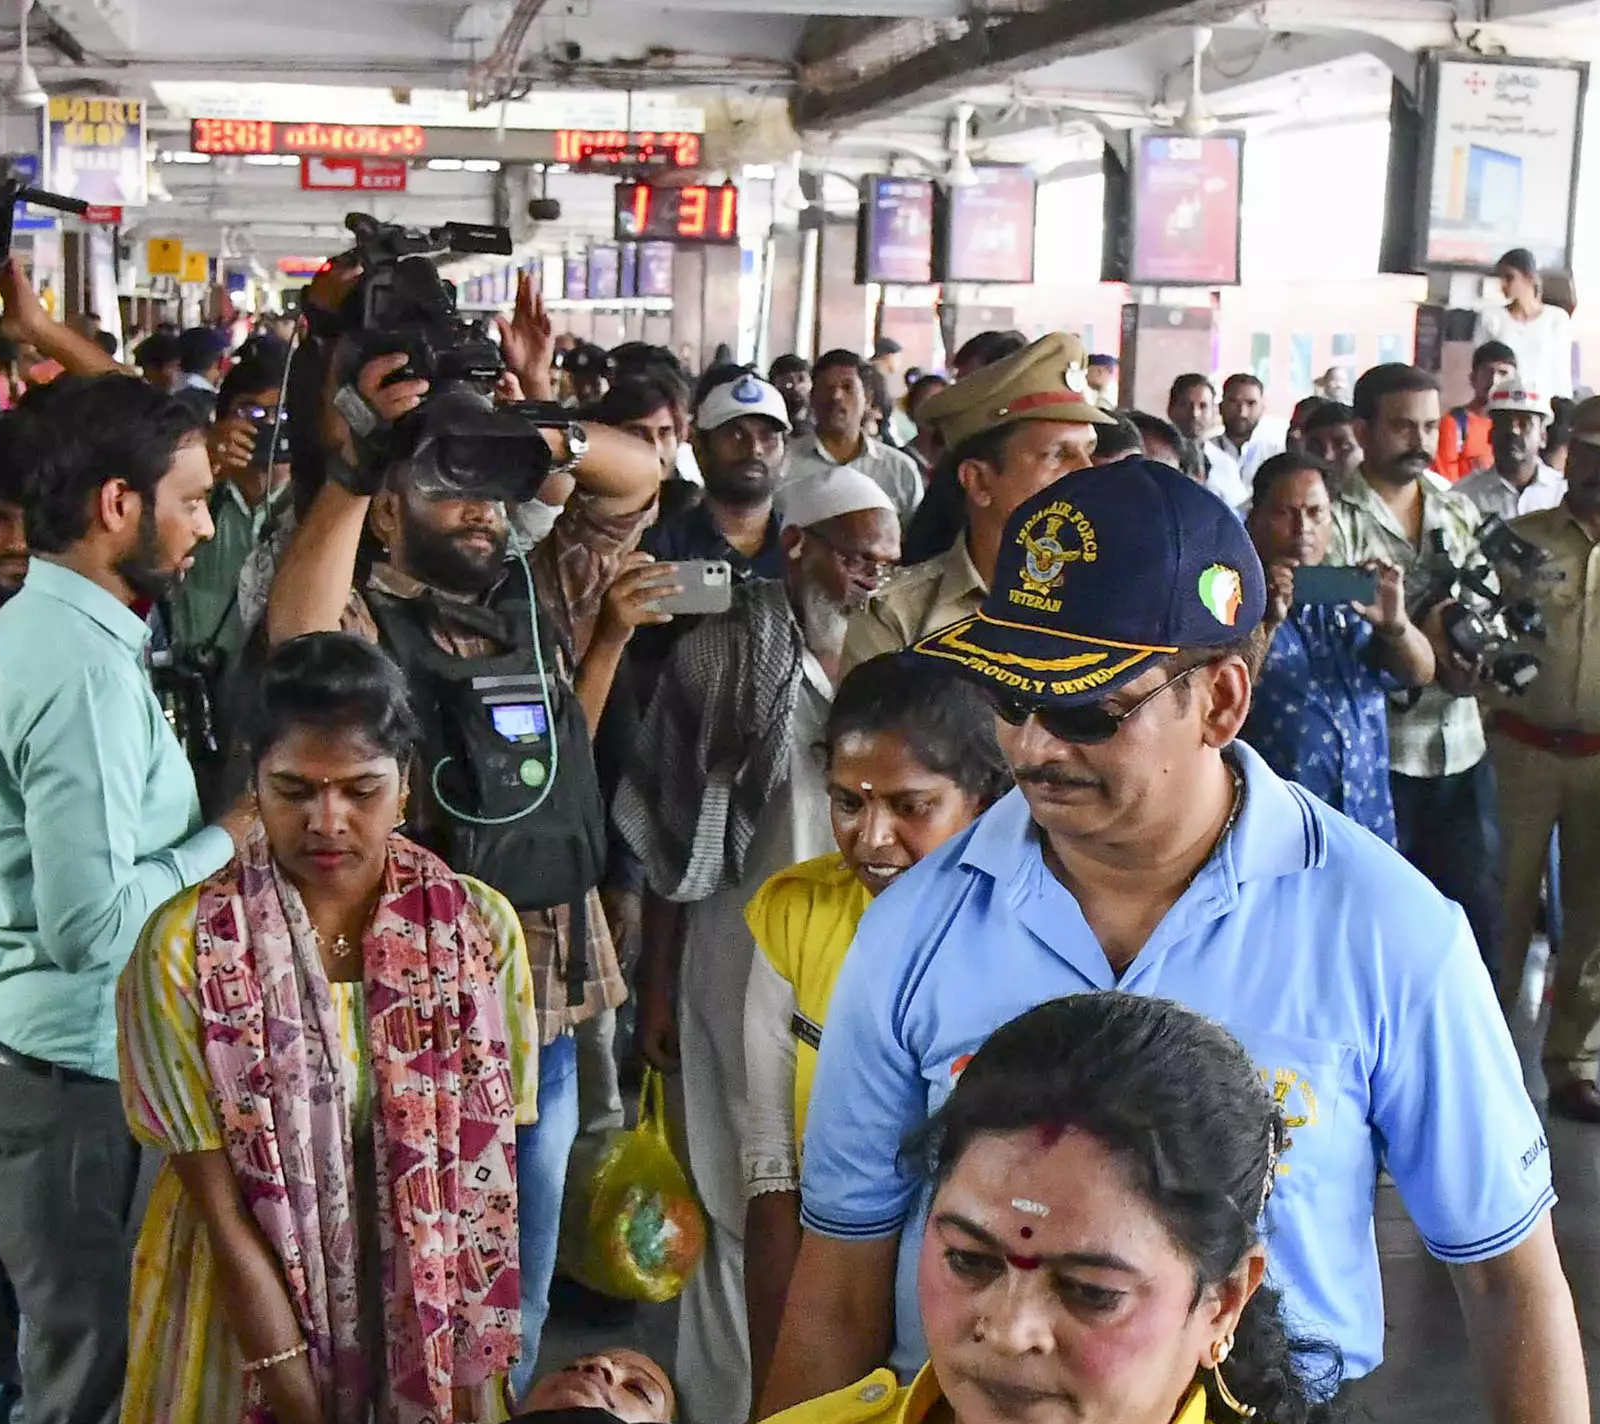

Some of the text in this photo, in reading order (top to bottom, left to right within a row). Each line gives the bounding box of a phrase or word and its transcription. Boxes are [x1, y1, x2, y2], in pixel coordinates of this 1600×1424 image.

[1050, 501, 1073, 518] AIR
[1069, 511, 1098, 562] FORCE
[1008, 588, 1064, 613] VETERAN
[966, 652, 1115, 695] PROUDLY SERVED
